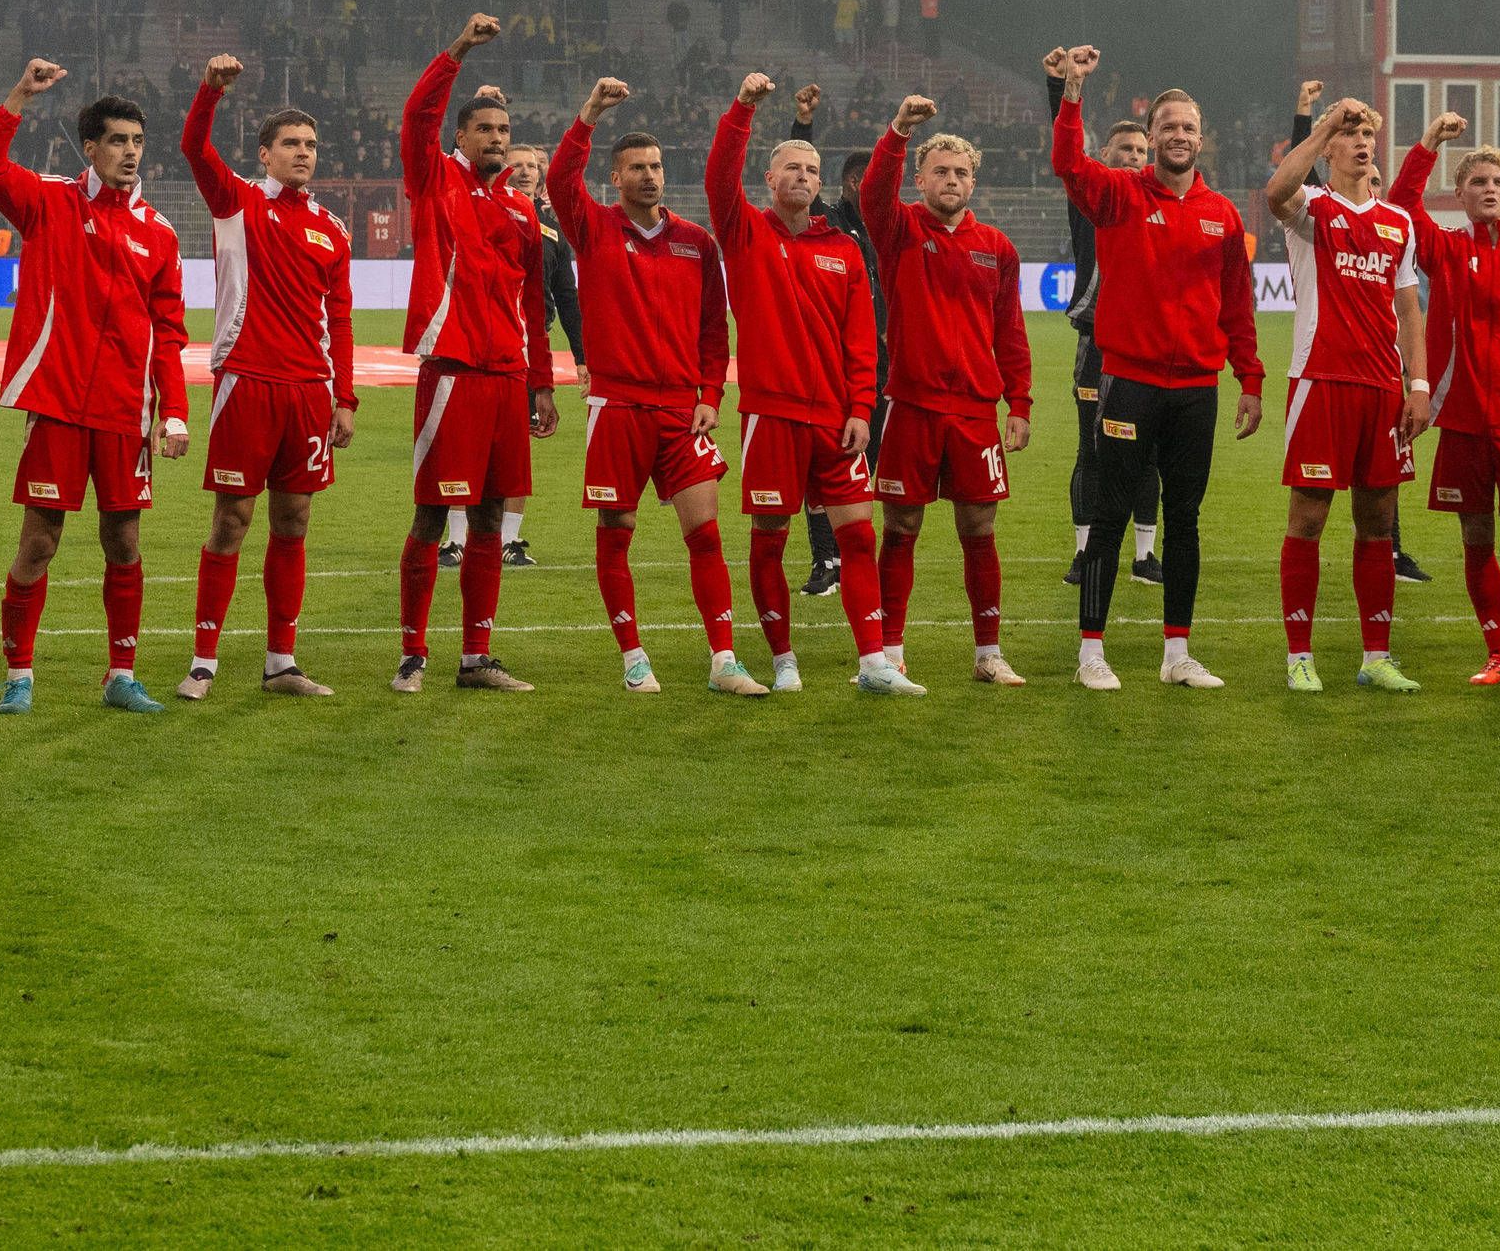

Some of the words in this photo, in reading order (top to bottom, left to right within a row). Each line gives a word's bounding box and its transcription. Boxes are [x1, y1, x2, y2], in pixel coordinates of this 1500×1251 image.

[371, 213, 390, 226] Tor
[374, 229, 389, 240] 13
[1336, 252, 1393, 274] proAF
[1341, 269, 1358, 278] ALTE
[135, 446, 151, 483] 4
[981, 443, 1005, 481] 16
